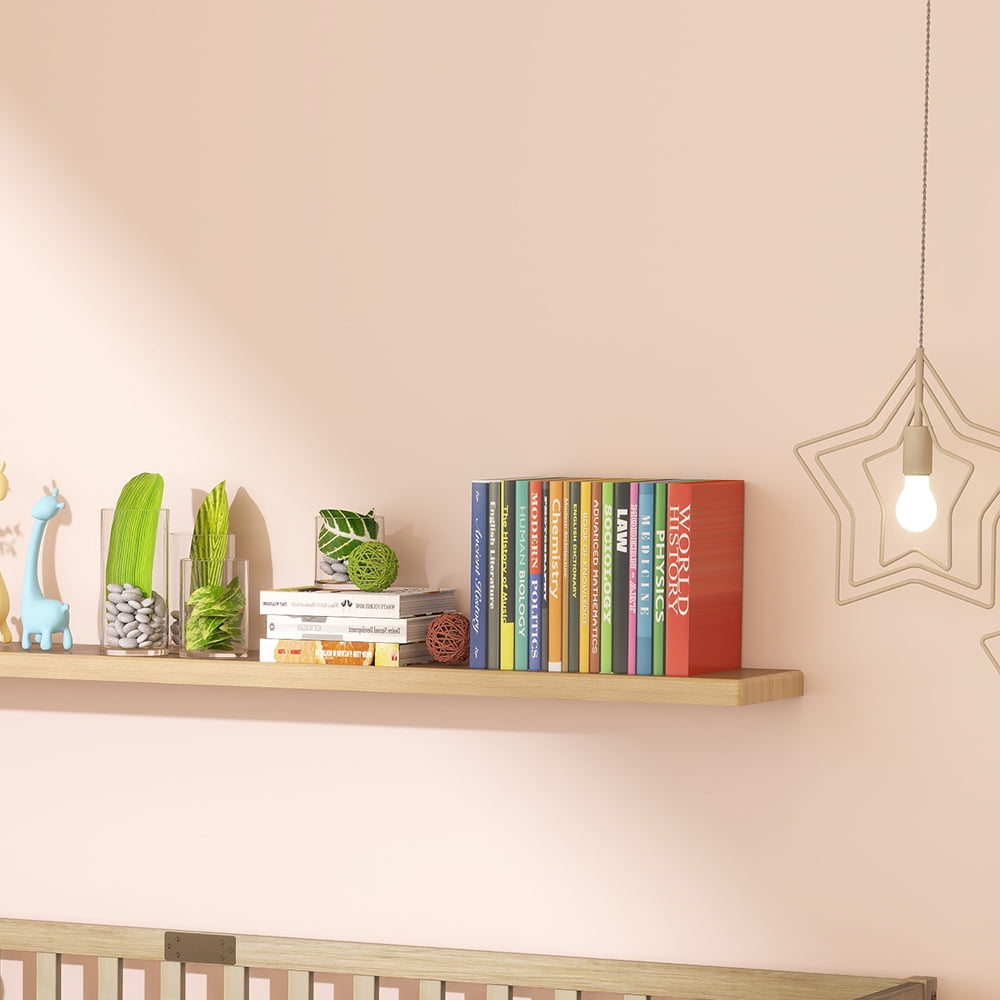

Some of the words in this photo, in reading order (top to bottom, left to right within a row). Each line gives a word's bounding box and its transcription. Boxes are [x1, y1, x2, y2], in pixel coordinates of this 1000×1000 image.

[530, 492, 539, 569] MODERN
[549, 498, 561, 599] Chemistry
[602, 504, 612, 624] SOCIOLOGY
[617, 508, 628, 553] LAW
[641, 515, 650, 615] MEDICINE
[655, 530, 665, 623] PHYSICS
[668, 506, 680, 615] HISTORY
[678, 504, 691, 616] WORLD
[518, 570, 526, 637] BIOLOGY
[530, 580, 538, 659] POLITICS
